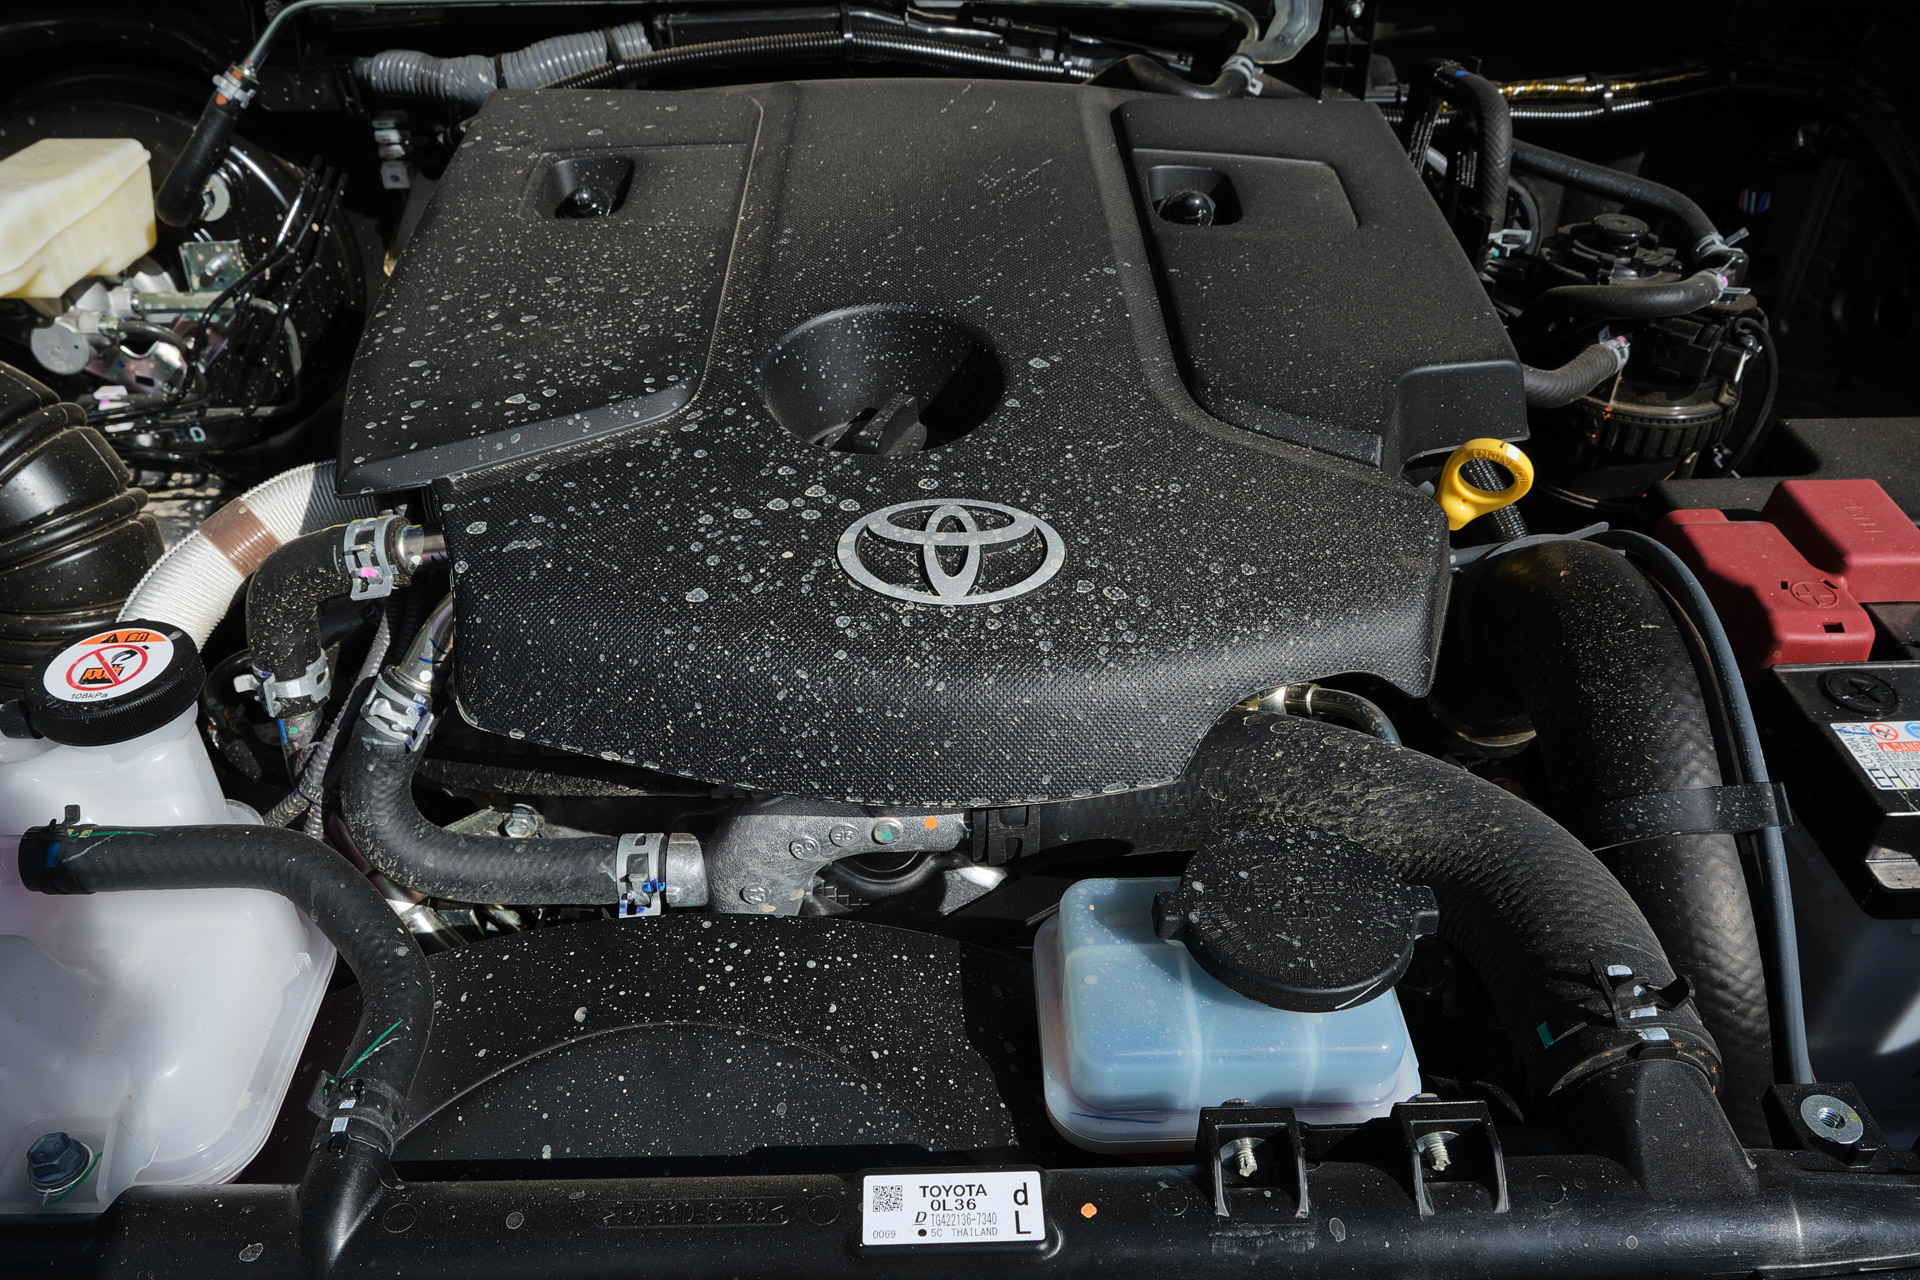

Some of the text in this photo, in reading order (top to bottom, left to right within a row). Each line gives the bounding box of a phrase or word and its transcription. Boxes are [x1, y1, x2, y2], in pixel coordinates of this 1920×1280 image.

[1473, 450, 1528, 484] ENGINE OIL
[1203, 880, 1386, 897] POWER STEERING
[1269, 904, 1334, 920] FLUID
[919, 1184, 987, 1198] TOYOTA
[1013, 1182, 1029, 1206] d
[931, 1212, 998, 1227] TG422136-7340
[1014, 1210, 1032, 1235] L
[872, 1229, 897, 1239] 0069
[952, 1227, 998, 1237] THAILAND
